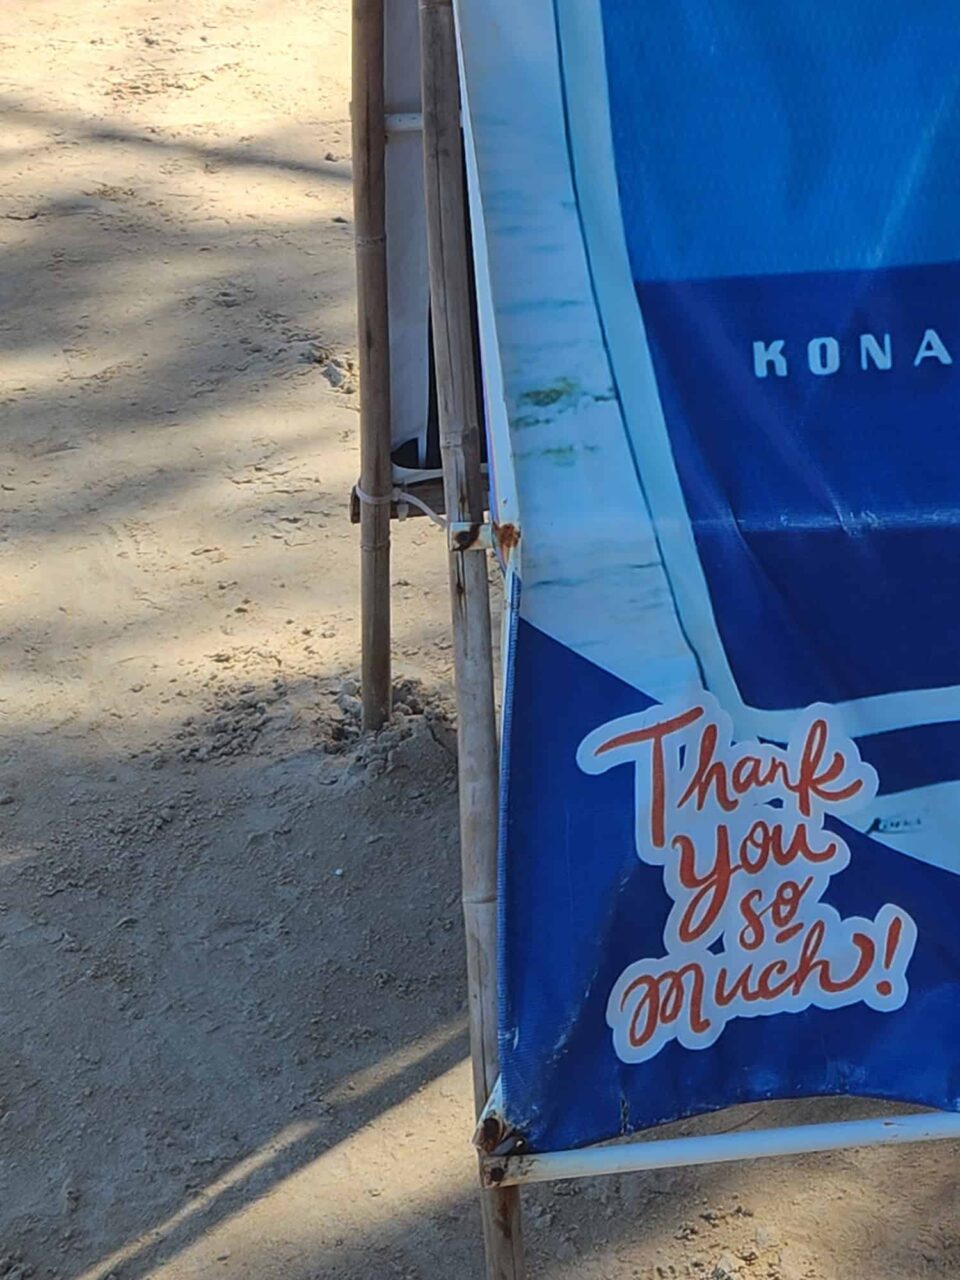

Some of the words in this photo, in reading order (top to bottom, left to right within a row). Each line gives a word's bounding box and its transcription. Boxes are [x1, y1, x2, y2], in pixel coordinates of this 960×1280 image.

[753, 328, 953, 379] KONA
[594, 706, 863, 848] Thank
[672, 821, 836, 943] you
[739, 876, 814, 950] so
